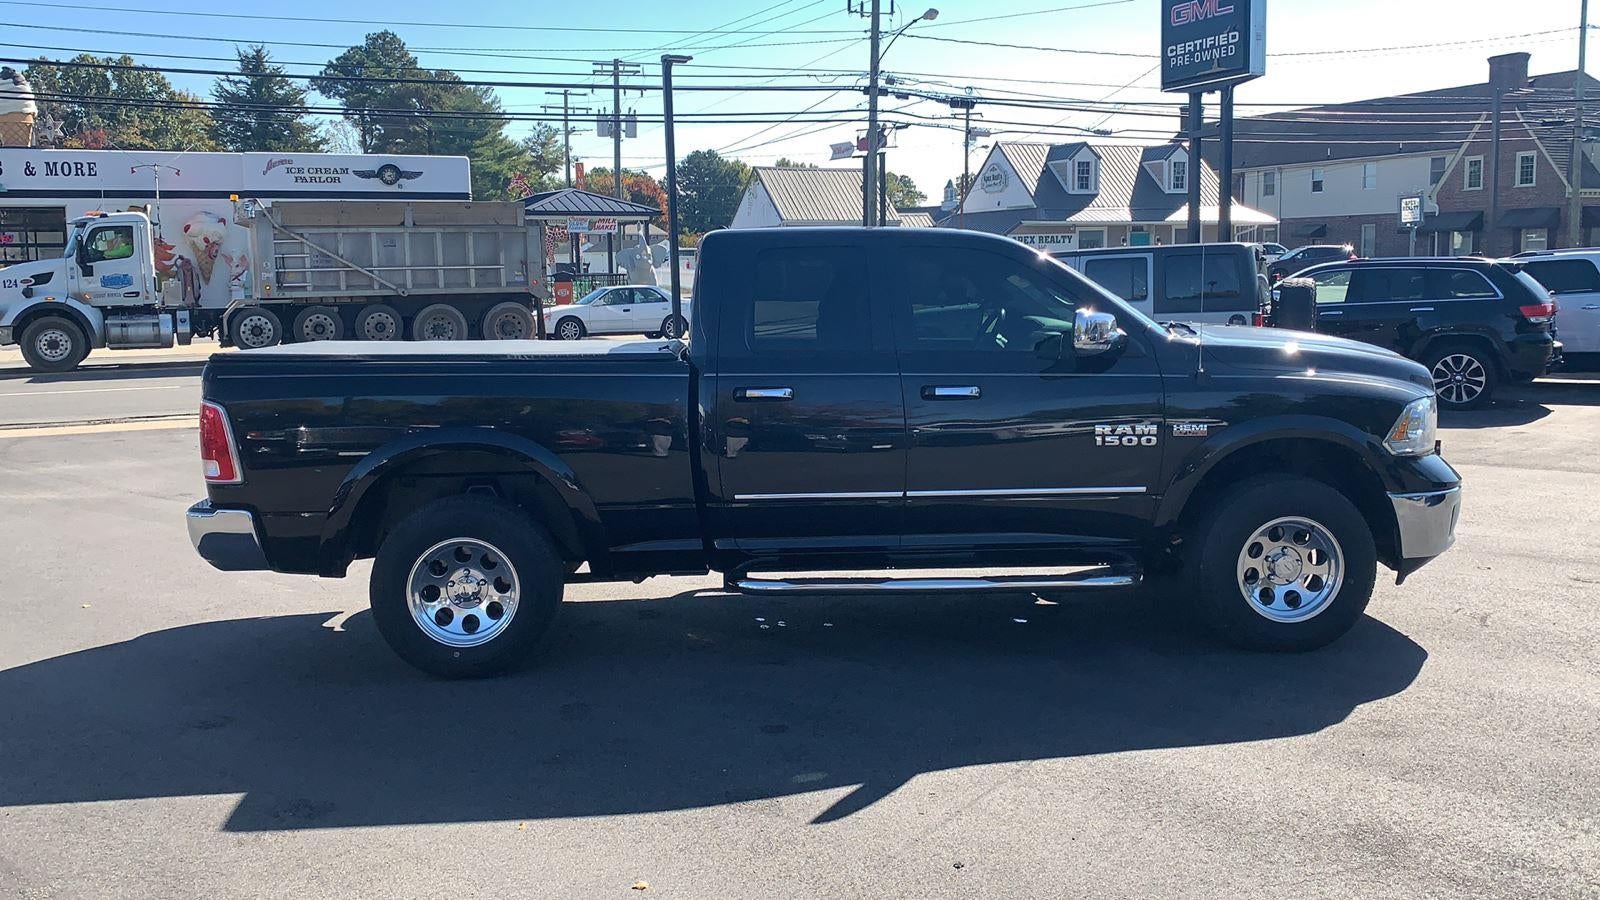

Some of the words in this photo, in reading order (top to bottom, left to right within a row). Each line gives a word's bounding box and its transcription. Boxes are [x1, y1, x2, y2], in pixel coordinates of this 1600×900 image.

[1167, 31, 1239, 57] CERTIFIED
[1170, 45, 1235, 68] PRE-OWNED
[24, 161, 37, 177] &
[45, 161, 98, 177] MORE
[286, 167, 305, 175] ICE
[308, 167, 349, 175] CREAM
[294, 176, 341, 184] PARLOR
[1038, 235, 1073, 244] REALTY
[2, 279, 18, 288] 124
[1095, 424, 1158, 435] RAM
[1095, 435, 1157, 446] 1500
